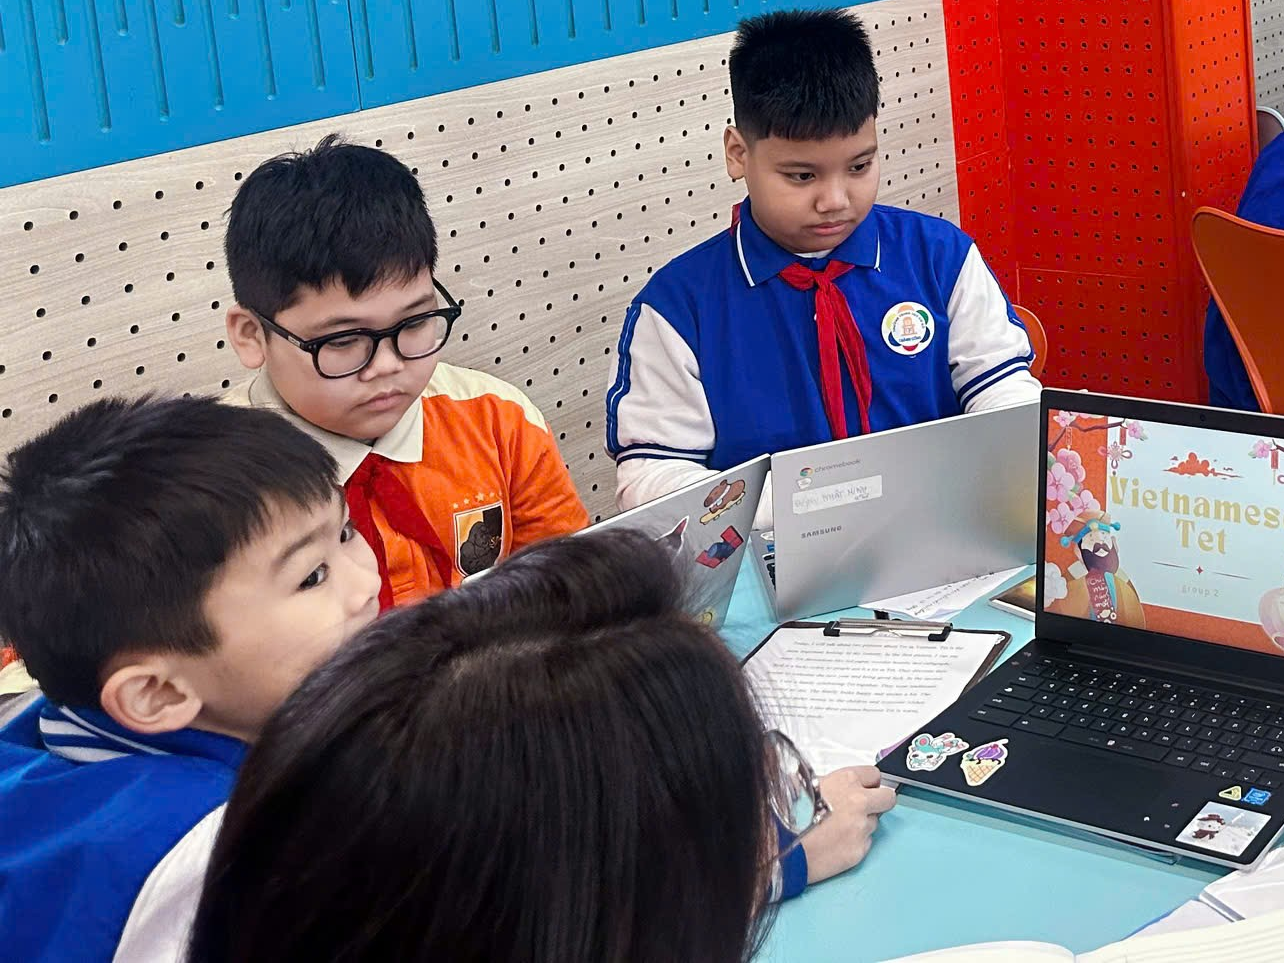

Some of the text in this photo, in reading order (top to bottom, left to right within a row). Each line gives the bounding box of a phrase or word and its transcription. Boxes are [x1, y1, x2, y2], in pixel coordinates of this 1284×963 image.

[801, 525, 842, 539] SAMSUNG
[1175, 518, 1227, 555] Tet
[1181, 584, 1220, 598] group 2
